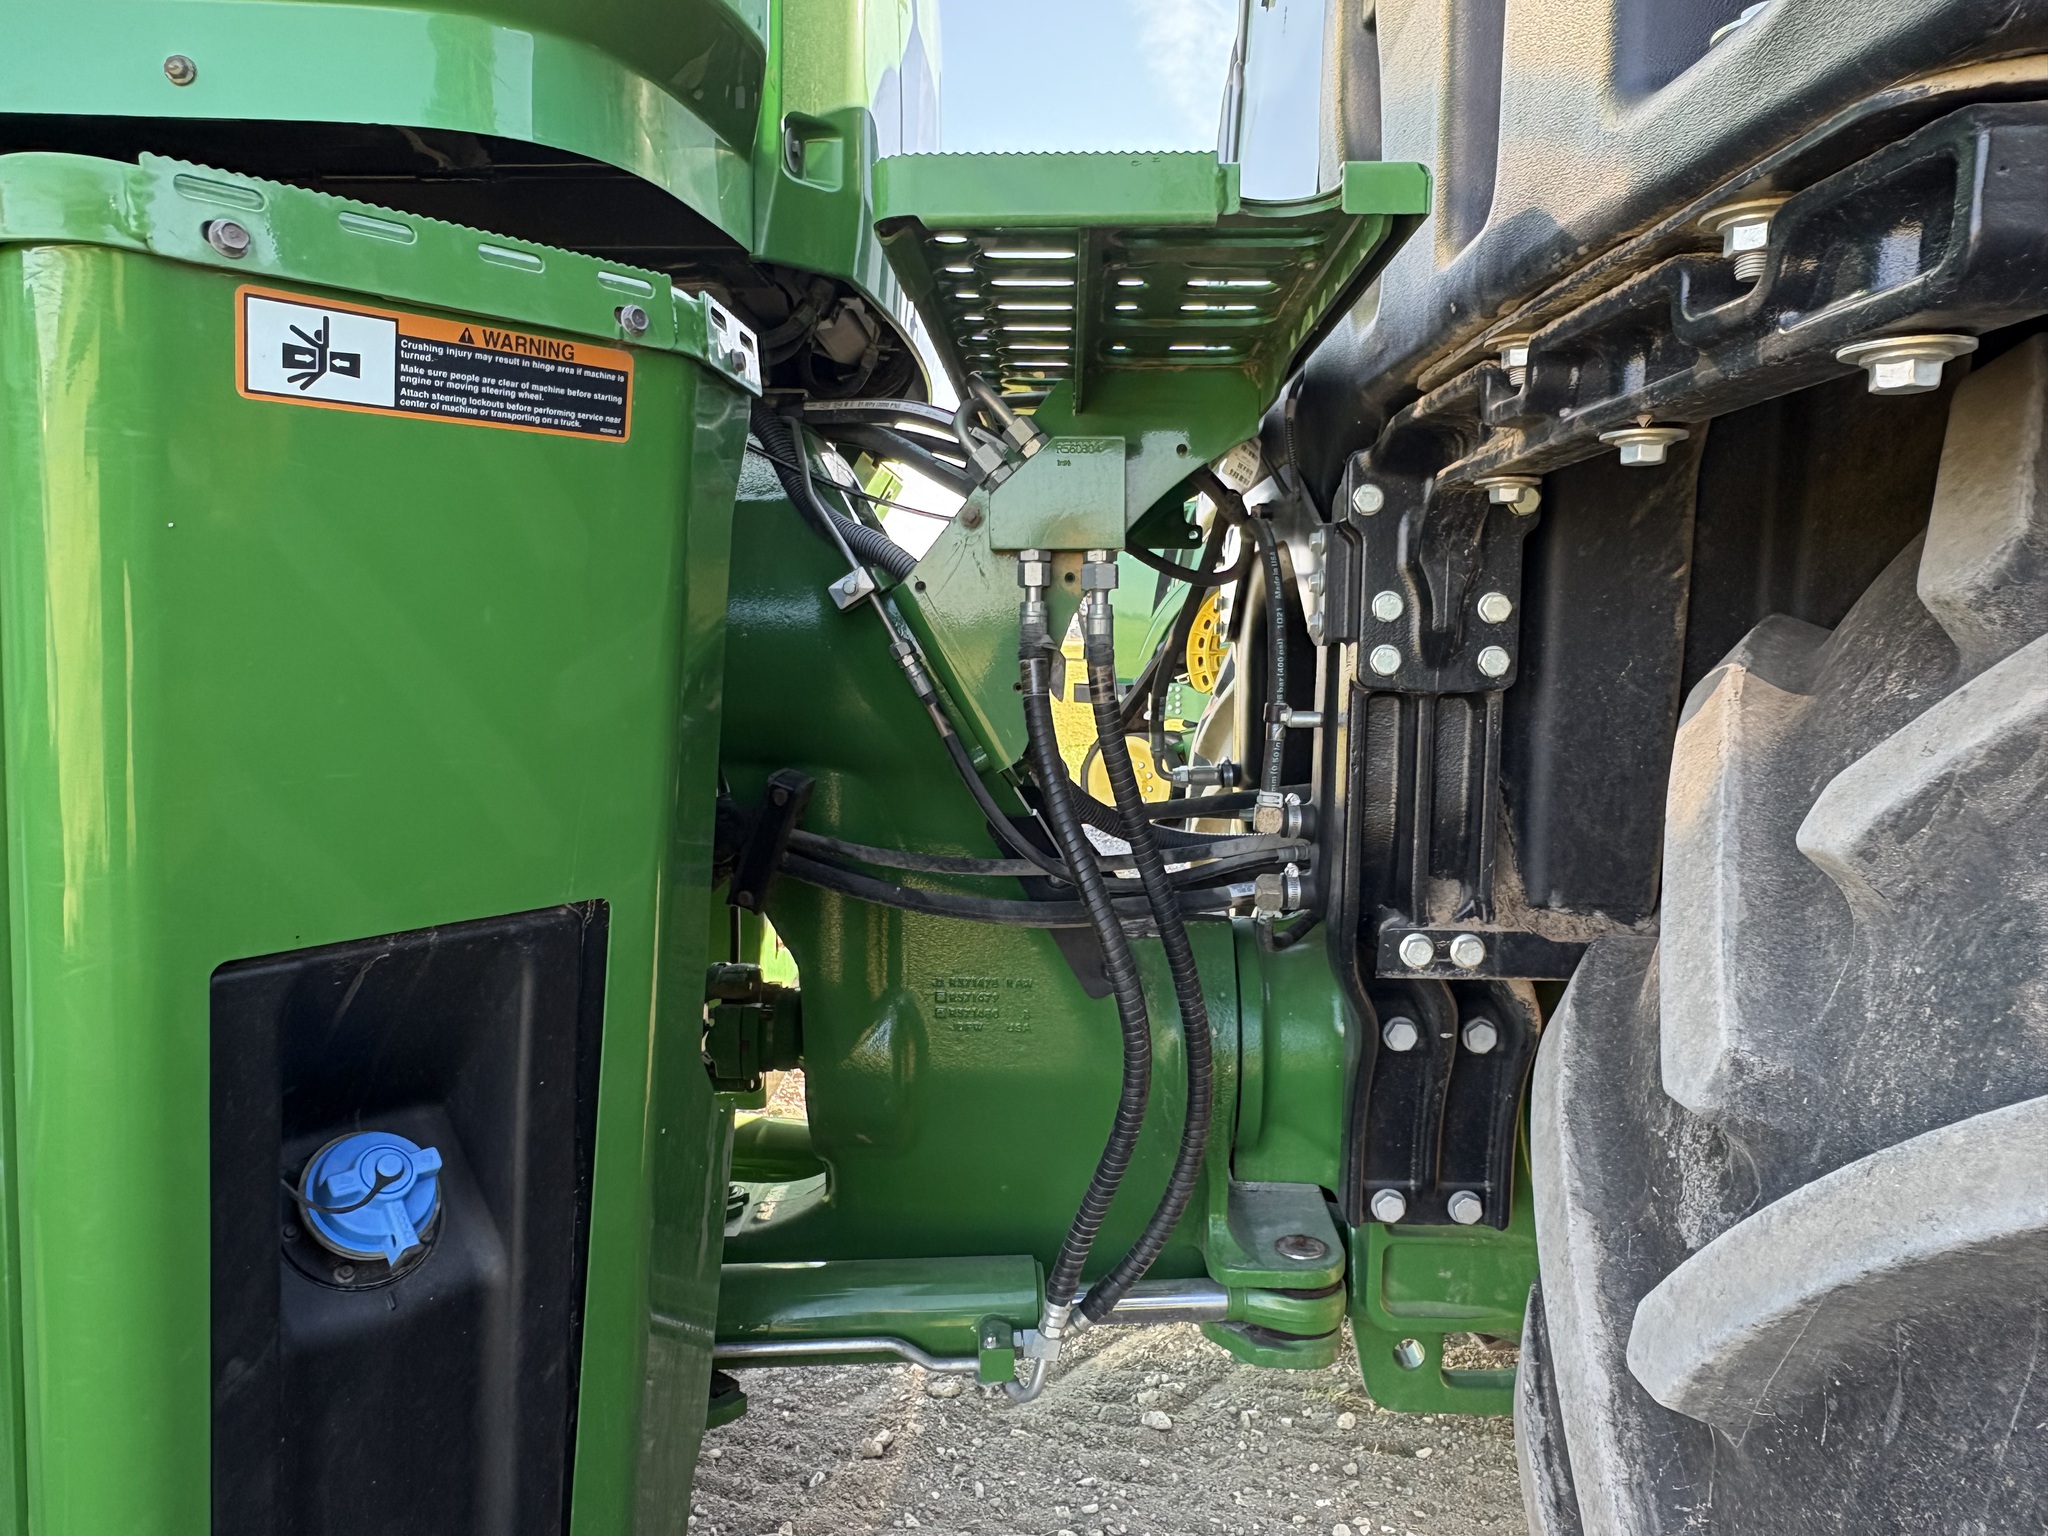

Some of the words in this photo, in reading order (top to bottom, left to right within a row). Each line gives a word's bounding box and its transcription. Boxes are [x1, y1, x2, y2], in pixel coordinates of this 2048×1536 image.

[400, 349, 434, 362] turned.
[482, 329, 575, 361] WARNING
[400, 339, 444, 356] Crushing
[446, 346, 473, 360] injury
[474, 352, 493, 364] may
[495, 355, 520, 366] result
[522, 358, 530, 367] in
[532, 360, 555, 372] hinge
[557, 365, 575, 375] area
[576, 367, 583, 376] if
[583, 368, 616, 382] machine
[617, 374, 625, 382] is
[400, 363, 425, 375] Make
[427, 368, 448, 378] sure
[450, 371, 480, 385] people
[482, 376, 496, 385] are
[498, 378, 519, 389] clear
[520, 381, 530, 389] of
[531, 383, 565, 395] machine
[567, 387, 592, 399] before
[593, 392, 623, 405] starting
[400, 375, 432, 386] engine
[434, 379, 444, 387] or
[446, 381, 479, 394] moving
[481, 385, 516, 399] steering
[518, 391, 544, 401] wheel.
[399, 398, 429, 409] center
[430, 401, 439, 410] of
[441, 404, 478, 415] machine
[479, 408, 489, 416] or
[490, 409, 540, 424] transporting
[541, 416, 552, 424] on
[553, 417, 559, 425] a
[560, 419, 582, 428] truck.
[400, 387, 429, 399] Attach
[432, 392, 466, 406] steering
[469, 396, 504, 409] lockouts
[506, 401, 532, 412] before
[533, 405, 576, 419] performing
[577, 411, 604, 422] service
[605, 416, 622, 424] near
[1269, 551, 1278, 567] USA
[1274, 576, 1282, 600] Made
[1276, 607, 1284, 629] 1021
